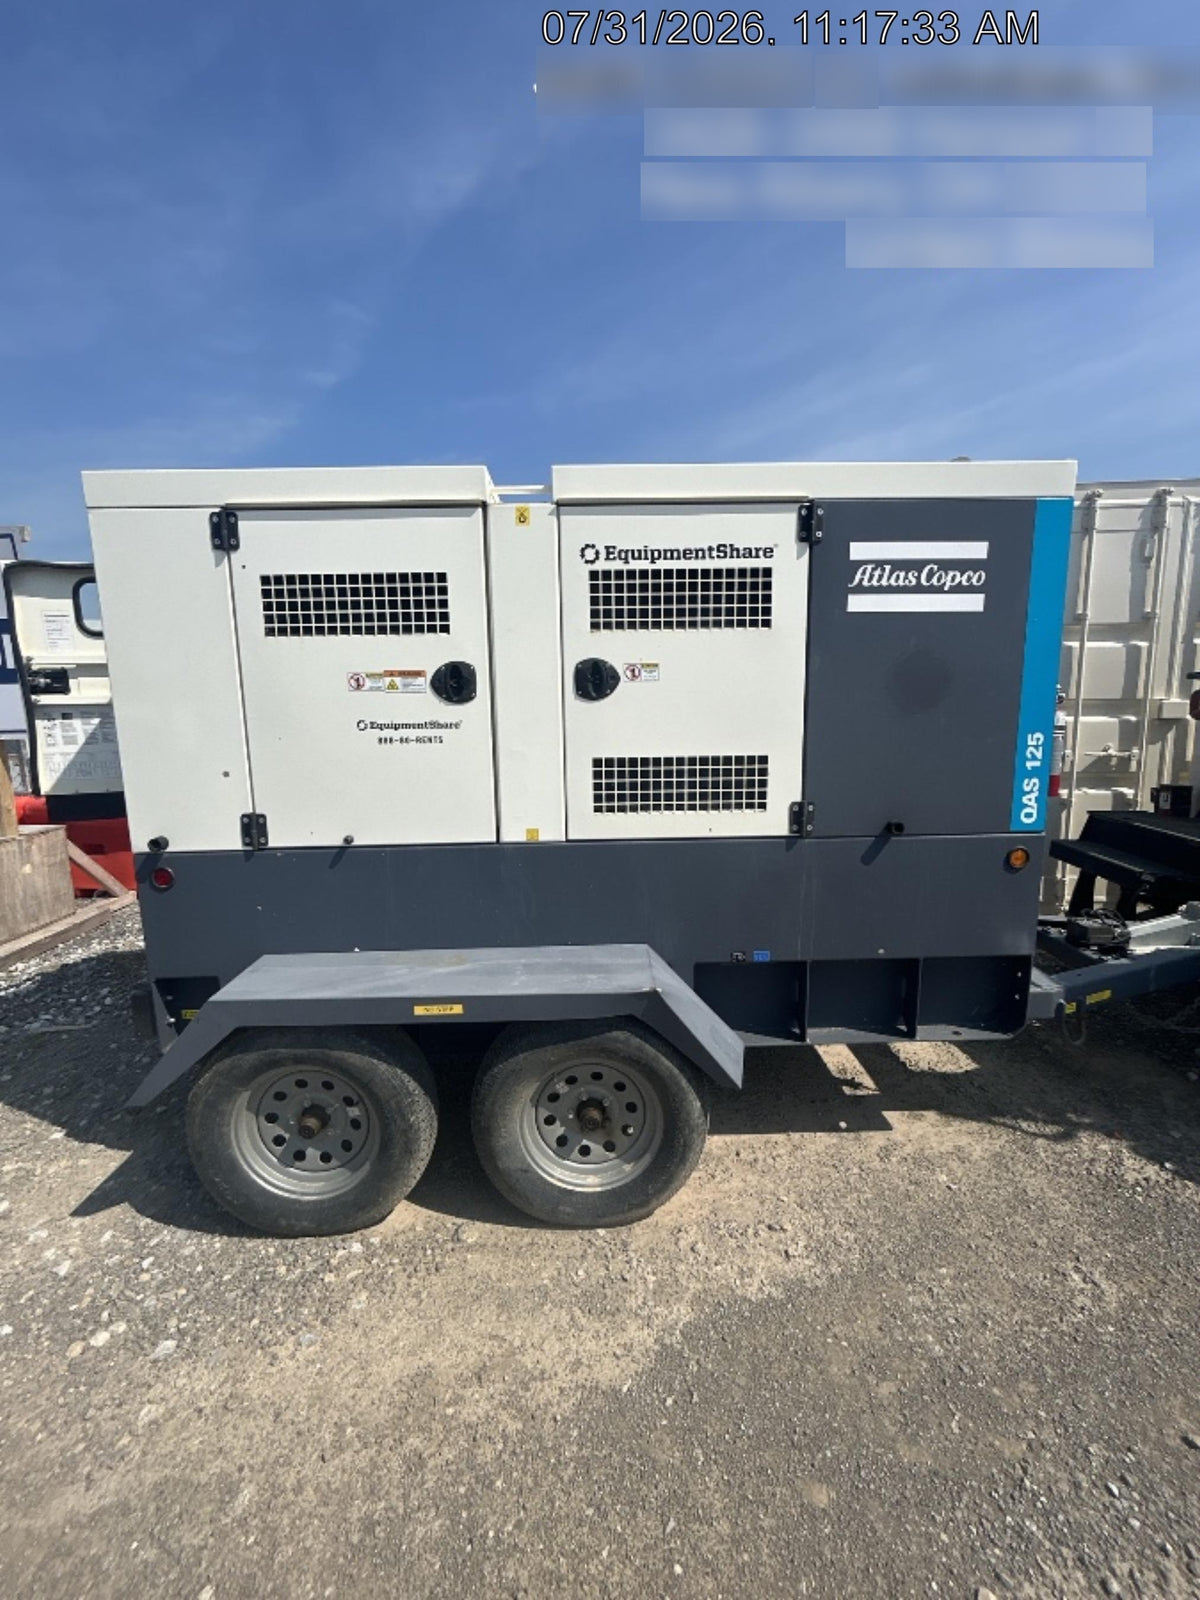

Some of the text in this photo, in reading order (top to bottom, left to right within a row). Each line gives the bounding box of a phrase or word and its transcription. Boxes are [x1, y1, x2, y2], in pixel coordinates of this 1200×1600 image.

[604, 543, 775, 564] EquipmentShare
[848, 563, 986, 591] Atlas Copco
[369, 720, 461, 731] EquipmentShare
[1020, 731, 1045, 824] QAS 125
